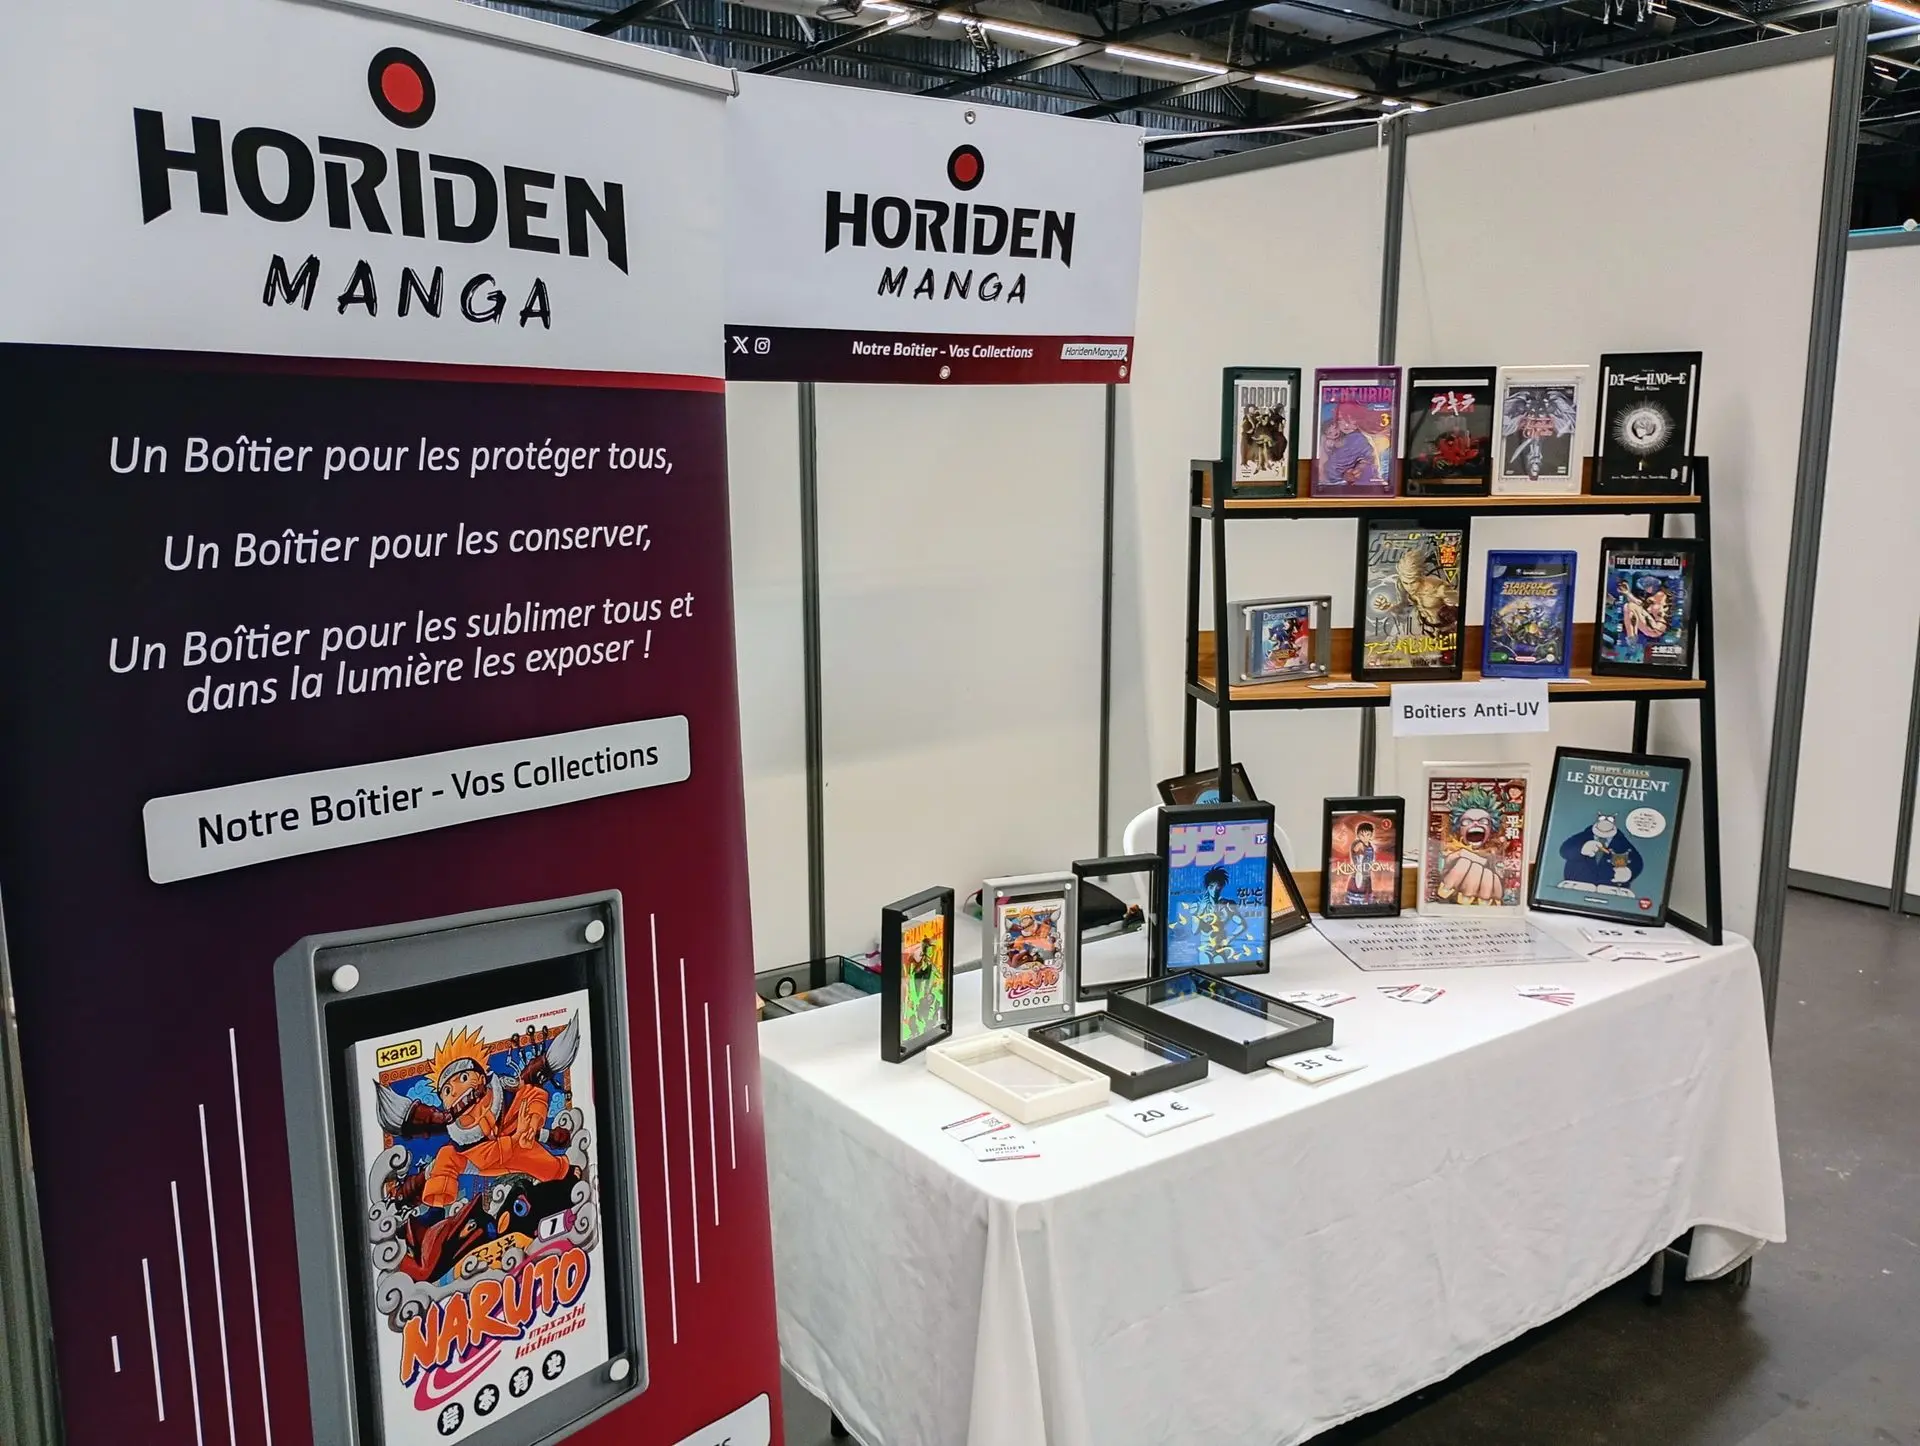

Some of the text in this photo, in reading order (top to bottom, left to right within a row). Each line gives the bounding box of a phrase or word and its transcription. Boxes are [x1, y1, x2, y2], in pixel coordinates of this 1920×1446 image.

[133, 106, 629, 277] HORIDEN
[825, 190, 1075, 269] HORIDEN
[262, 254, 551, 330] MANGA
[877, 266, 1026, 304] MANGA
[852, 341, 891, 356] Notre
[893, 342, 938, 357] Boîtier
[949, 345, 970, 358] Vos
[972, 345, 1033, 359] Collections
[1241, 386, 1288, 408] BORUTO
[1431, 391, 1475, 416] アキラ
[1380, 413, 1391, 427] 3
[110, 435, 674, 480] Un Boîtier pour les protéger tous,
[164, 523, 652, 570] Un Boîtier pour les conserver,
[1616, 557, 1626, 565] THE
[1263, 609, 1298, 621] Dreamcast
[109, 591, 695, 674] Un Boîtier pour les sublimer tous et
[187, 673, 278, 714] dans
[291, 666, 322, 700] la
[337, 651, 463, 696] lumière
[474, 643, 516, 679] les
[525, 638, 634, 677] exposer
[1404, 702, 1539, 719] Boîtiers Anti-UV
[1567, 771, 1669, 793] LE SUCCULENT
[1584, 784, 1648, 801] DU CHAT
[198, 803, 299, 849] Notre
[310, 784, 423, 827] Boîtier
[451, 770, 505, 800] Vos
[513, 743, 659, 789] Collections
[1257, 834, 1266, 845] 15
[1332, 861, 1395, 876] KINGDOM
[1004, 967, 1059, 992] NARUTO
[515, 1014, 539, 1023] VERSION
[1294, 1054, 1343, 1071] 35 €
[1134, 1101, 1189, 1123] 20 €
[549, 1218, 558, 1236] 1
[400, 1249, 591, 1387] NARUTO
[528, 1302, 586, 1340] masashi
[515, 1318, 586, 1360] kishimoto
